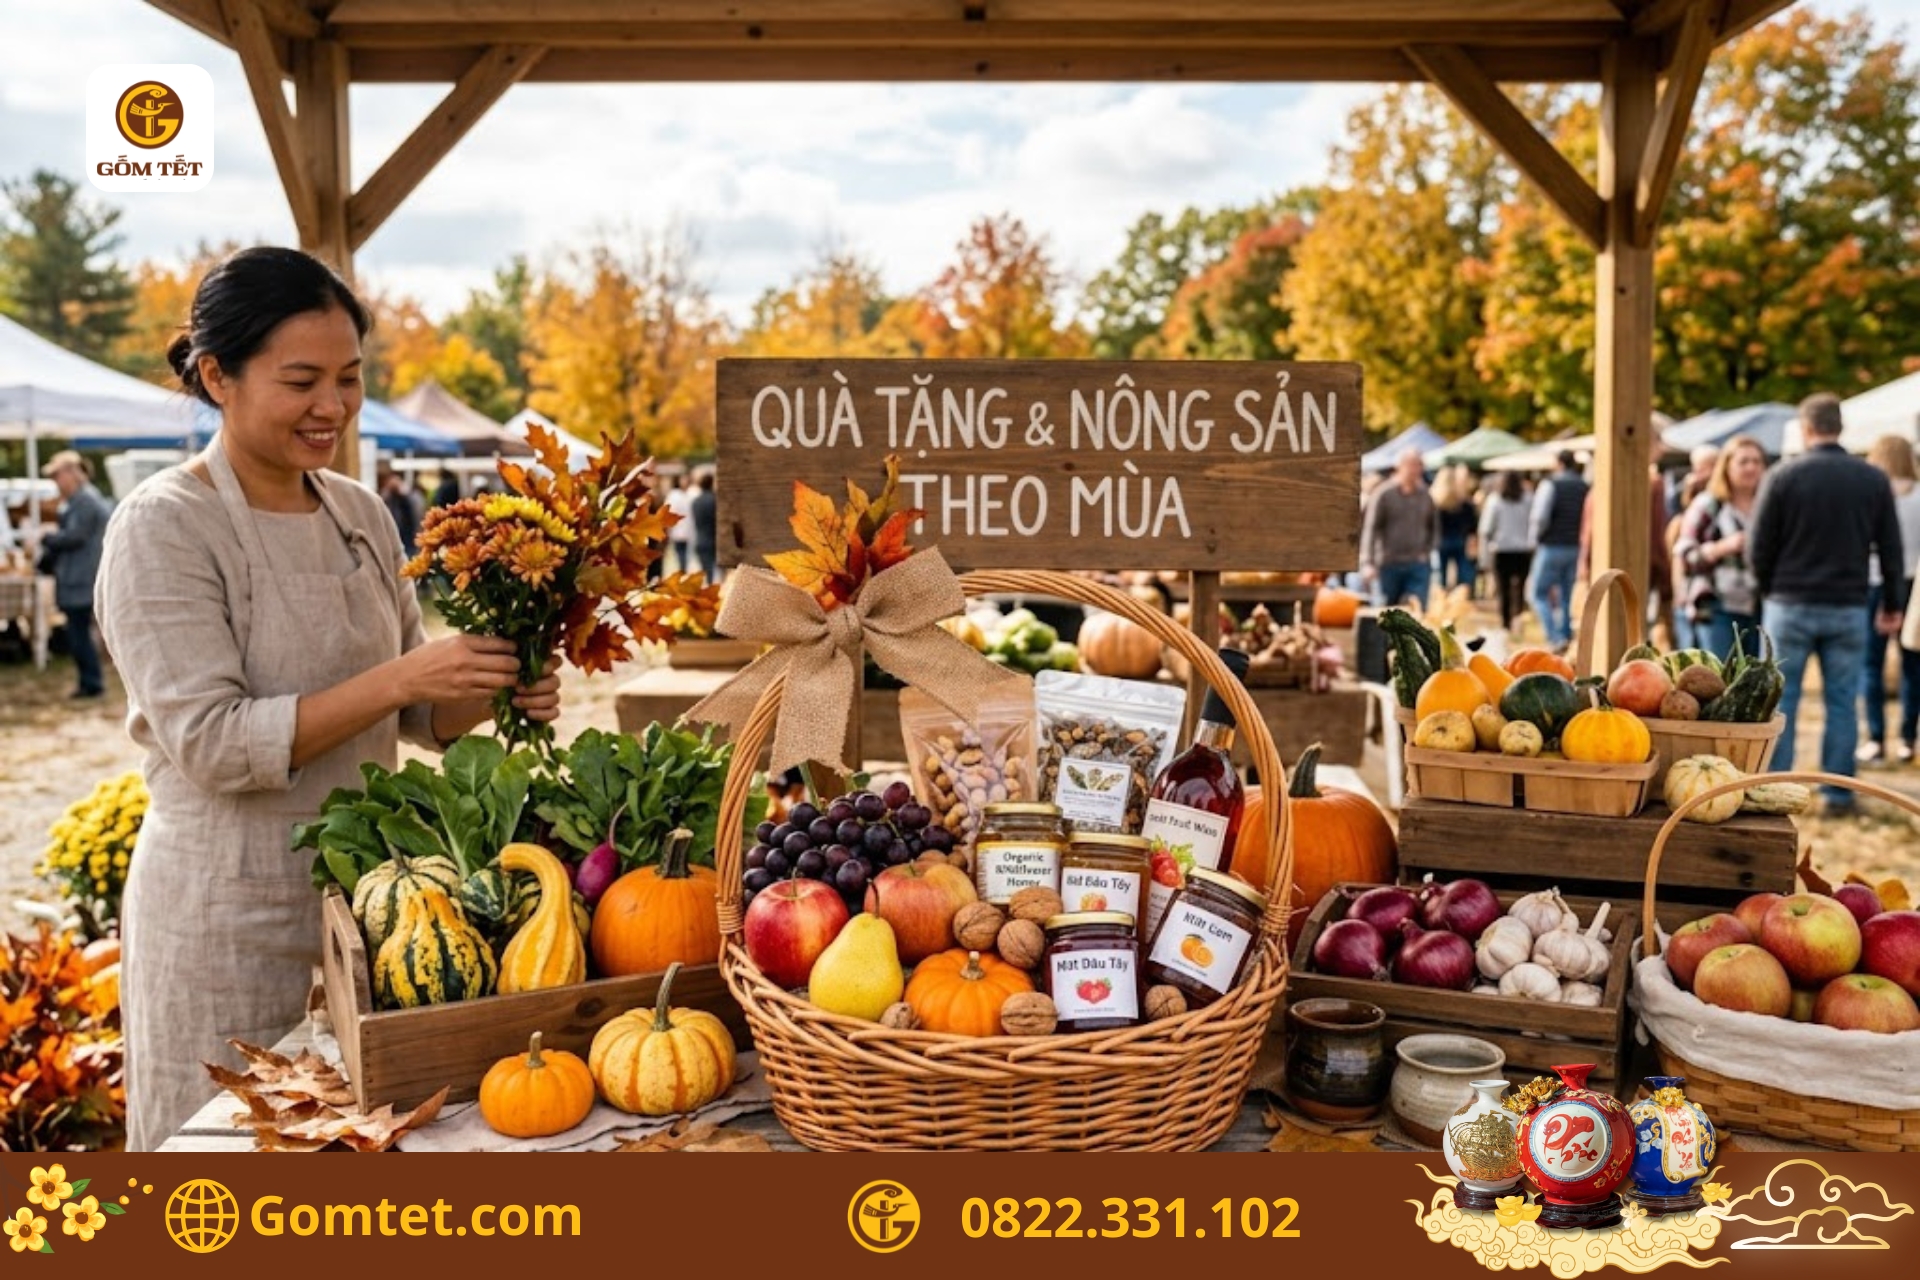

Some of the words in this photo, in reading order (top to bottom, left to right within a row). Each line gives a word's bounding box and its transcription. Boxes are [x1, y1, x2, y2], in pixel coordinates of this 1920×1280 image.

[751, 371, 863, 449] QUÀ
[875, 374, 1013, 459] TẶNG
[1025, 402, 1055, 446] &
[1070, 373, 1215, 452] NÔNG
[1230, 370, 1336, 453] SẢN
[899, 474, 1048, 537] THEO
[1070, 460, 1191, 538] MÙA
